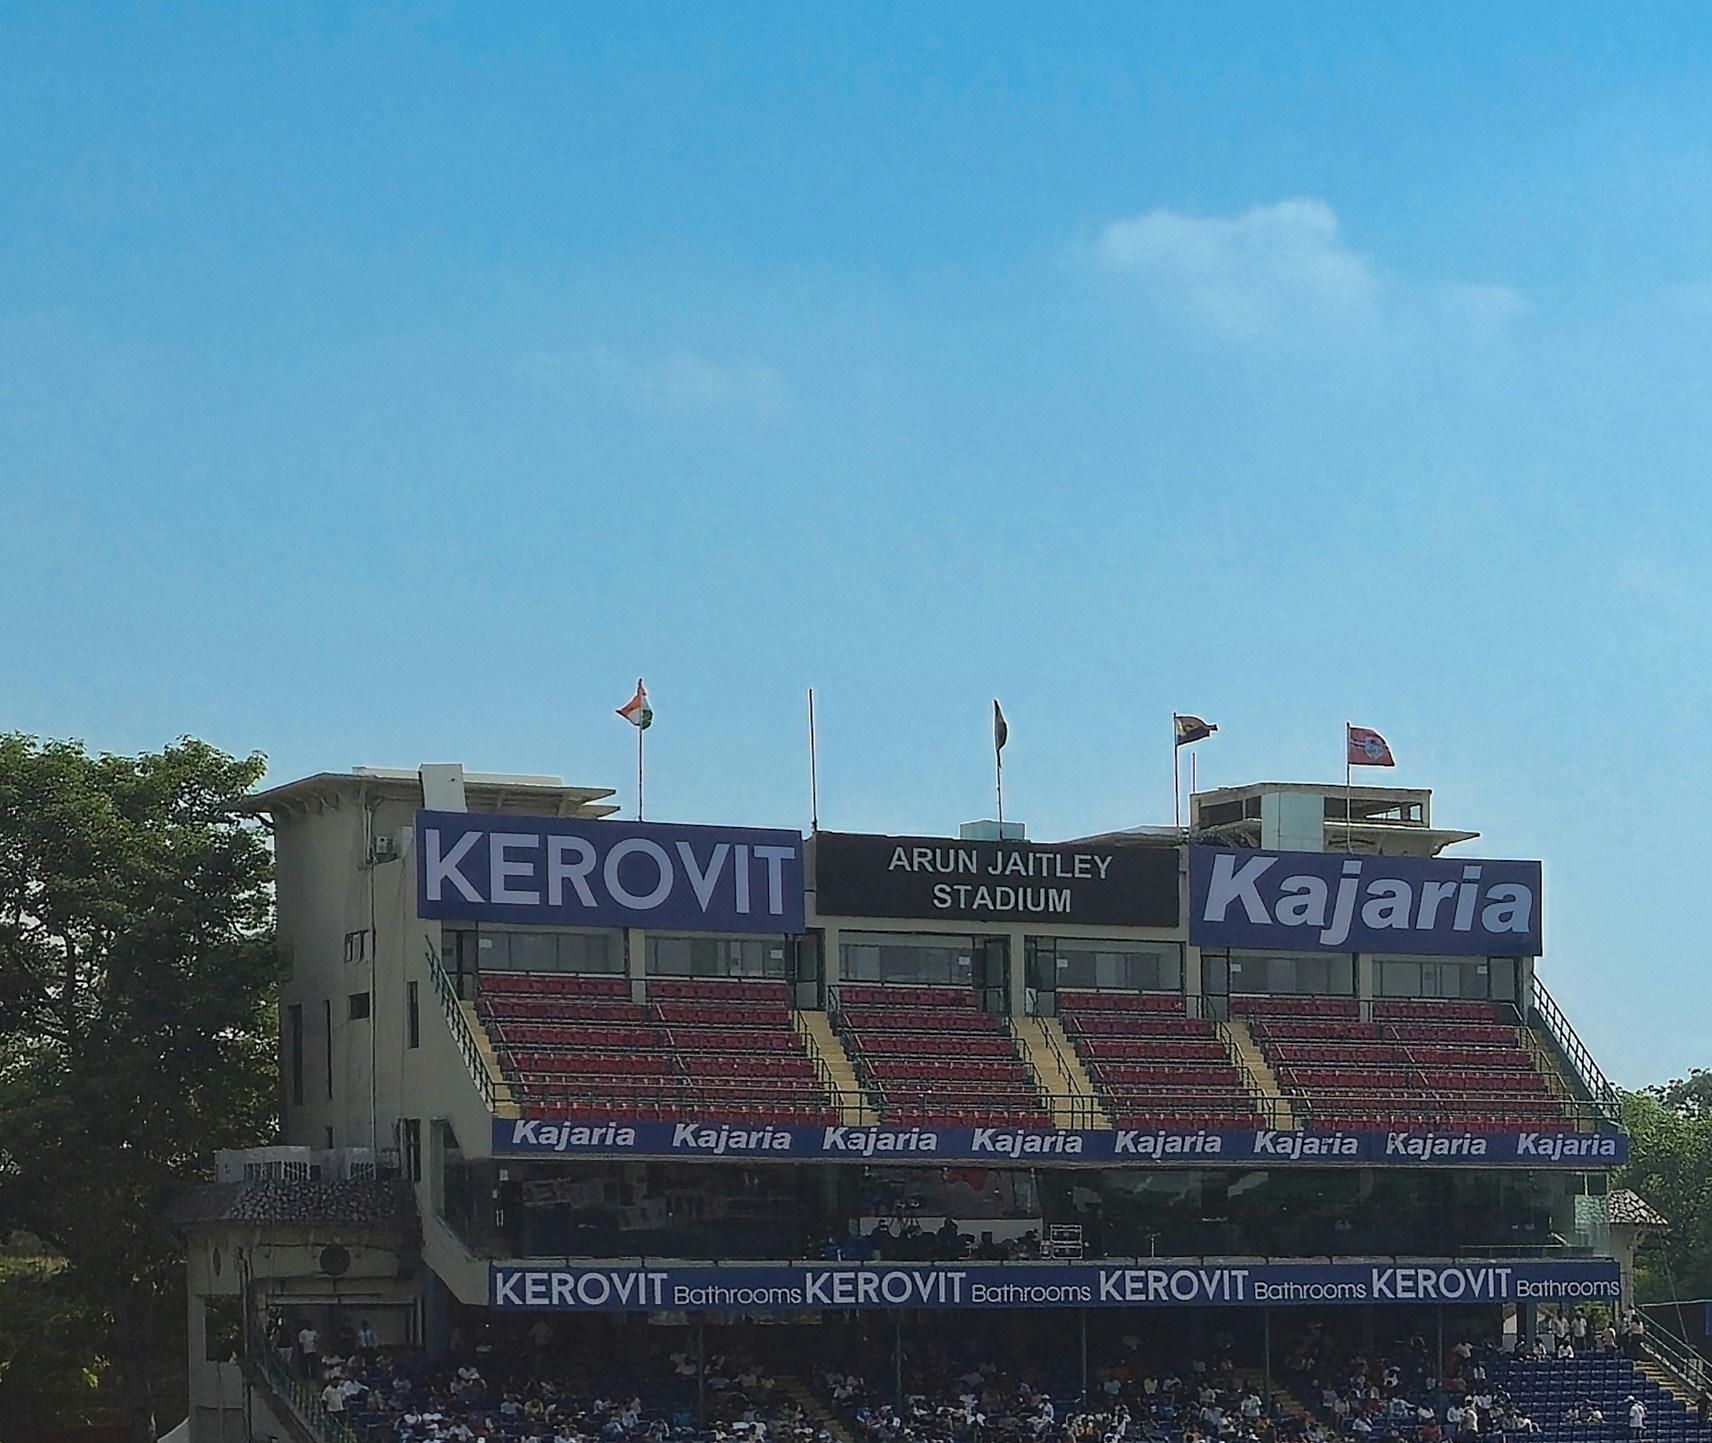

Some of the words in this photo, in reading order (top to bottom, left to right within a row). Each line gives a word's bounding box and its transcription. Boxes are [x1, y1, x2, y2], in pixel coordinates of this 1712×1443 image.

[425, 828, 795, 915] KEROVIT
[888, 846, 977, 874] ARUN
[988, 850, 1114, 880] JAITLEY
[932, 885, 1071, 913] STADIUM
[1203, 854, 1533, 945] Kajaria
[511, 1119, 636, 1151] Kajaria
[673, 1122, 791, 1152] Kajaria
[823, 1126, 937, 1154] Kajaria
[971, 1129, 1083, 1157] Kajaria
[1115, 1130, 1222, 1158] Kajaria
[1254, 1131, 1358, 1159] Kajaria
[1386, 1132, 1487, 1160] Kajaria
[1516, 1133, 1615, 1161] Kajaria
[496, 1272, 668, 1306] KEROVIT
[675, 1284, 802, 1305] Bathrooms
[806, 1271, 966, 1303] KEROVIT
[971, 1280, 1091, 1302] Bathrooms
[1100, 1270, 1249, 1301] KEROVIT
[1255, 1279, 1366, 1299] Bathrooms
[1371, 1269, 1511, 1298] KEROVIT
[1516, 1278, 1620, 1297] Bathrooms
